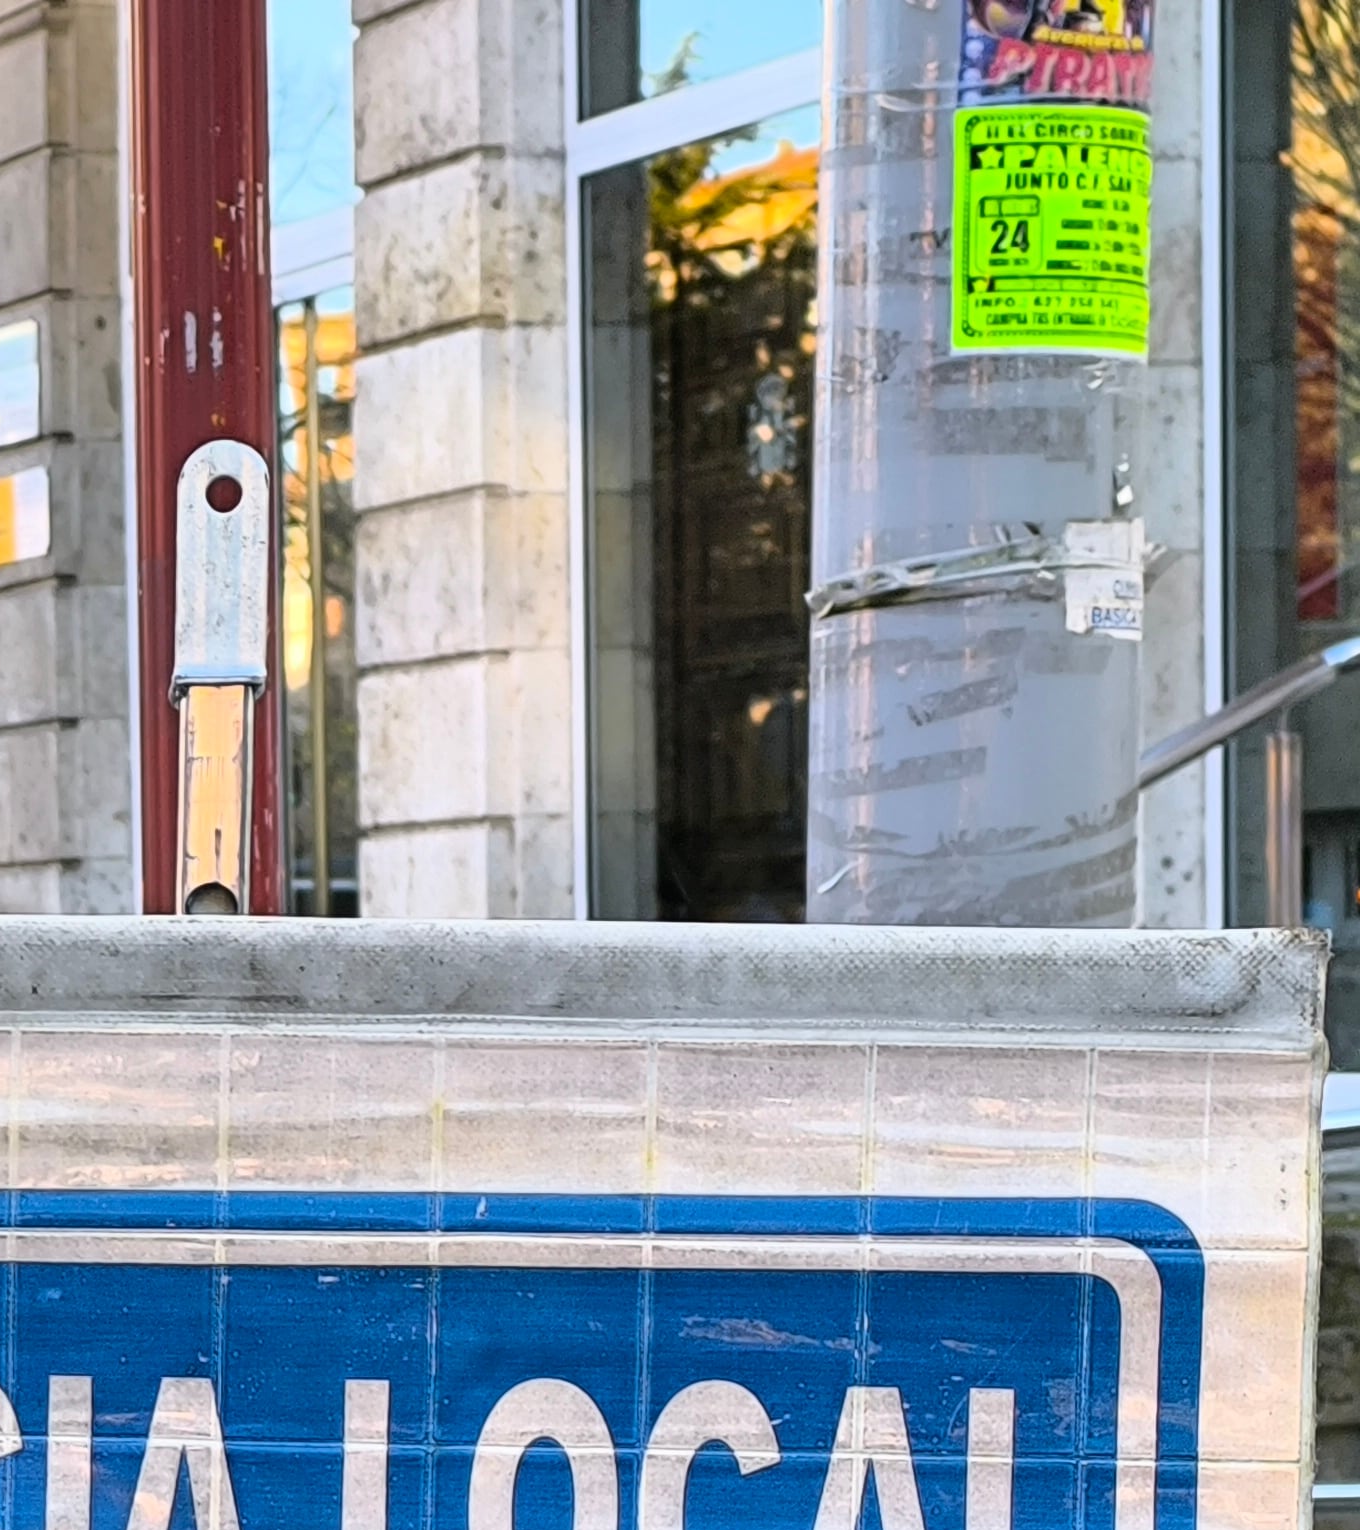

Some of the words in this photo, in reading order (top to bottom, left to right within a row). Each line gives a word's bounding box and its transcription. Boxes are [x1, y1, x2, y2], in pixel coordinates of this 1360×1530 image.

[1035, 123, 1093, 138] CIRCO
[1006, 172, 1068, 191] JUNTO
[991, 219, 1030, 254] 24
